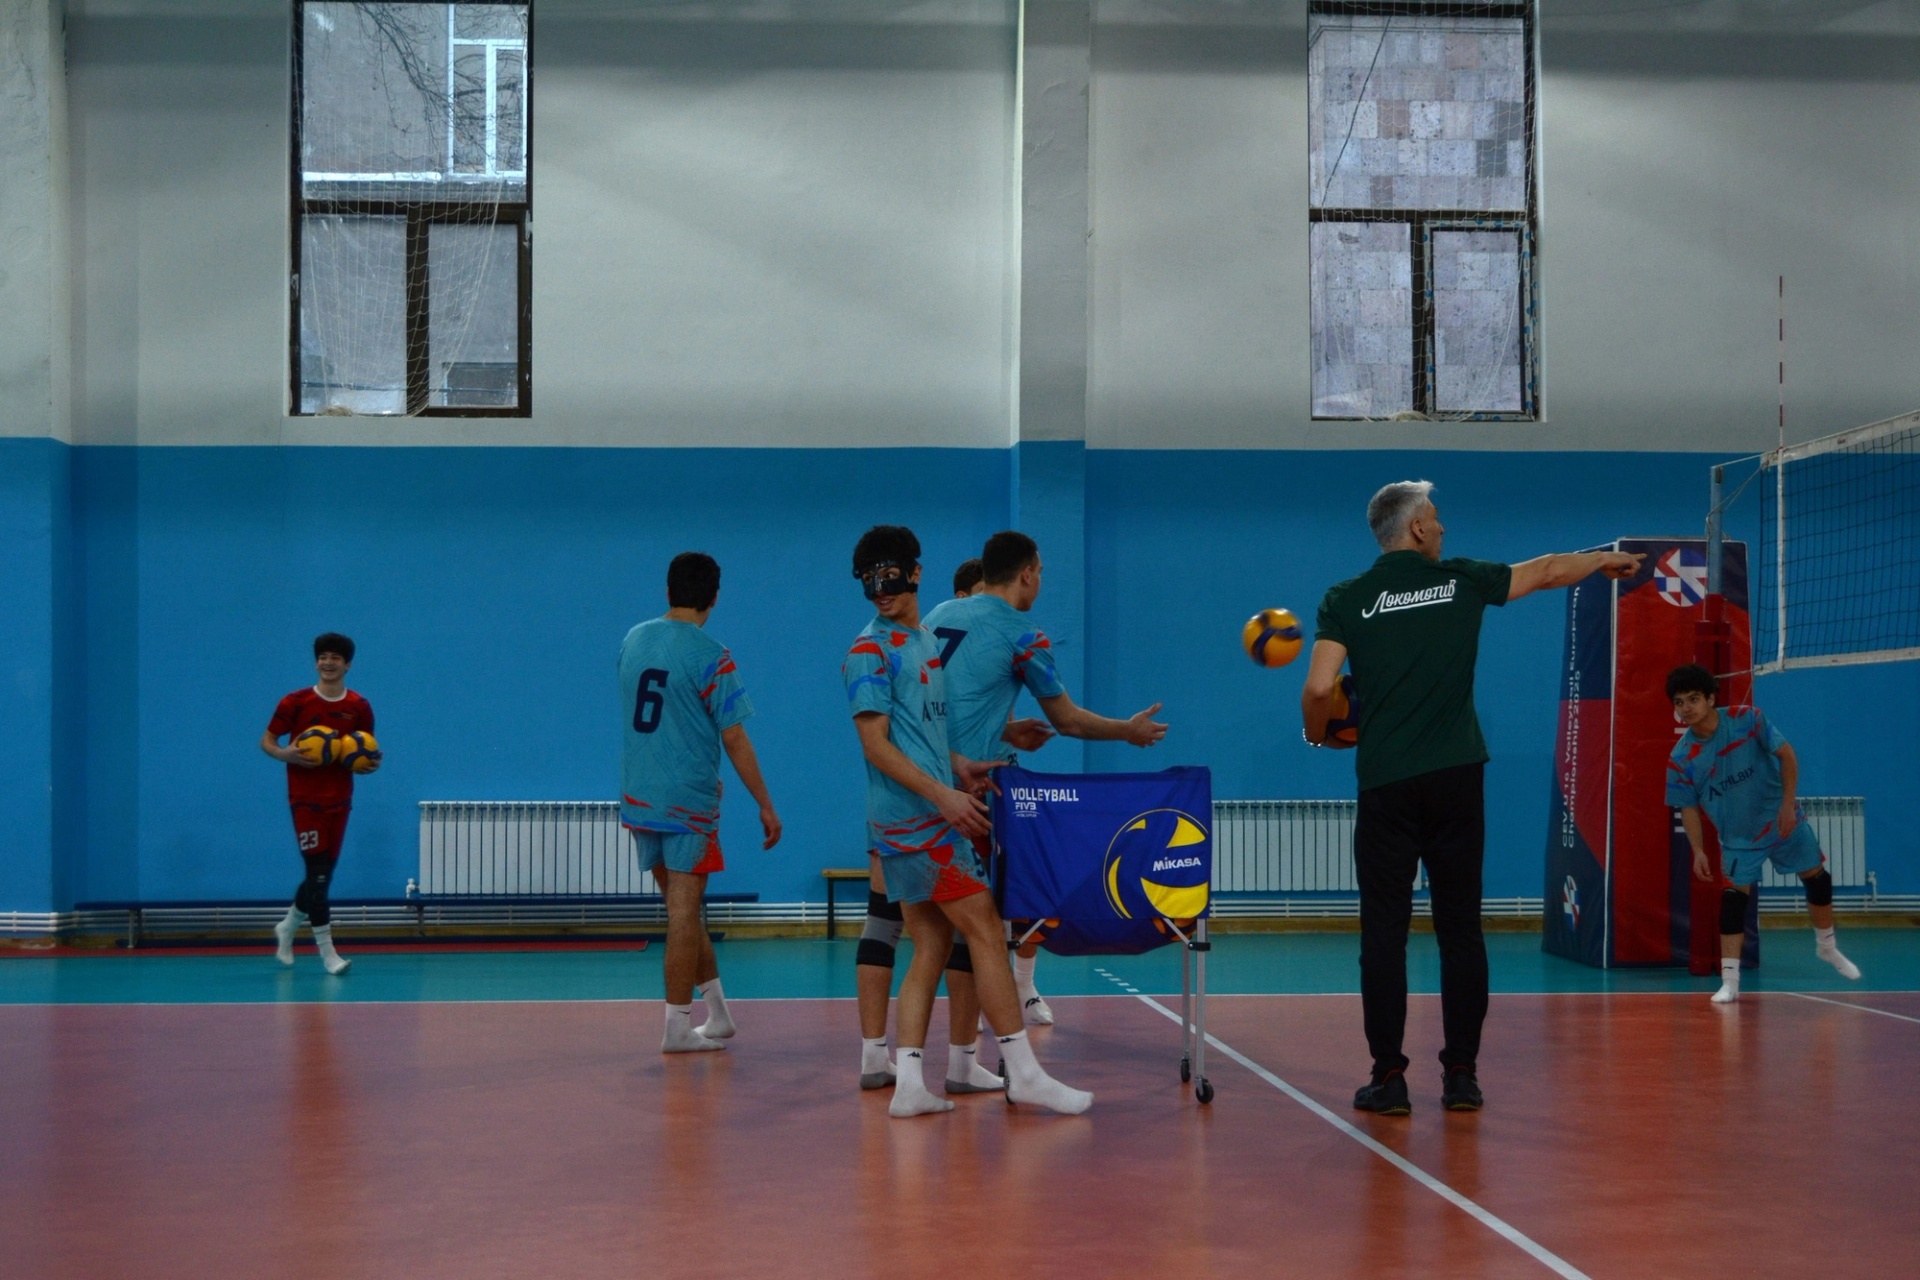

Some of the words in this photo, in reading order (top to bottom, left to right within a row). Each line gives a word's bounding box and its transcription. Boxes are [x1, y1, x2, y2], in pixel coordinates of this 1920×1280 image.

[1361, 579, 1457, 619] Локомотив
[933, 626, 968, 671] 7
[633, 668, 670, 734] 6
[1010, 787, 1080, 802] VOLLEYBALL
[1014, 802, 1037, 811] FIVB
[299, 830, 319, 851] 23
